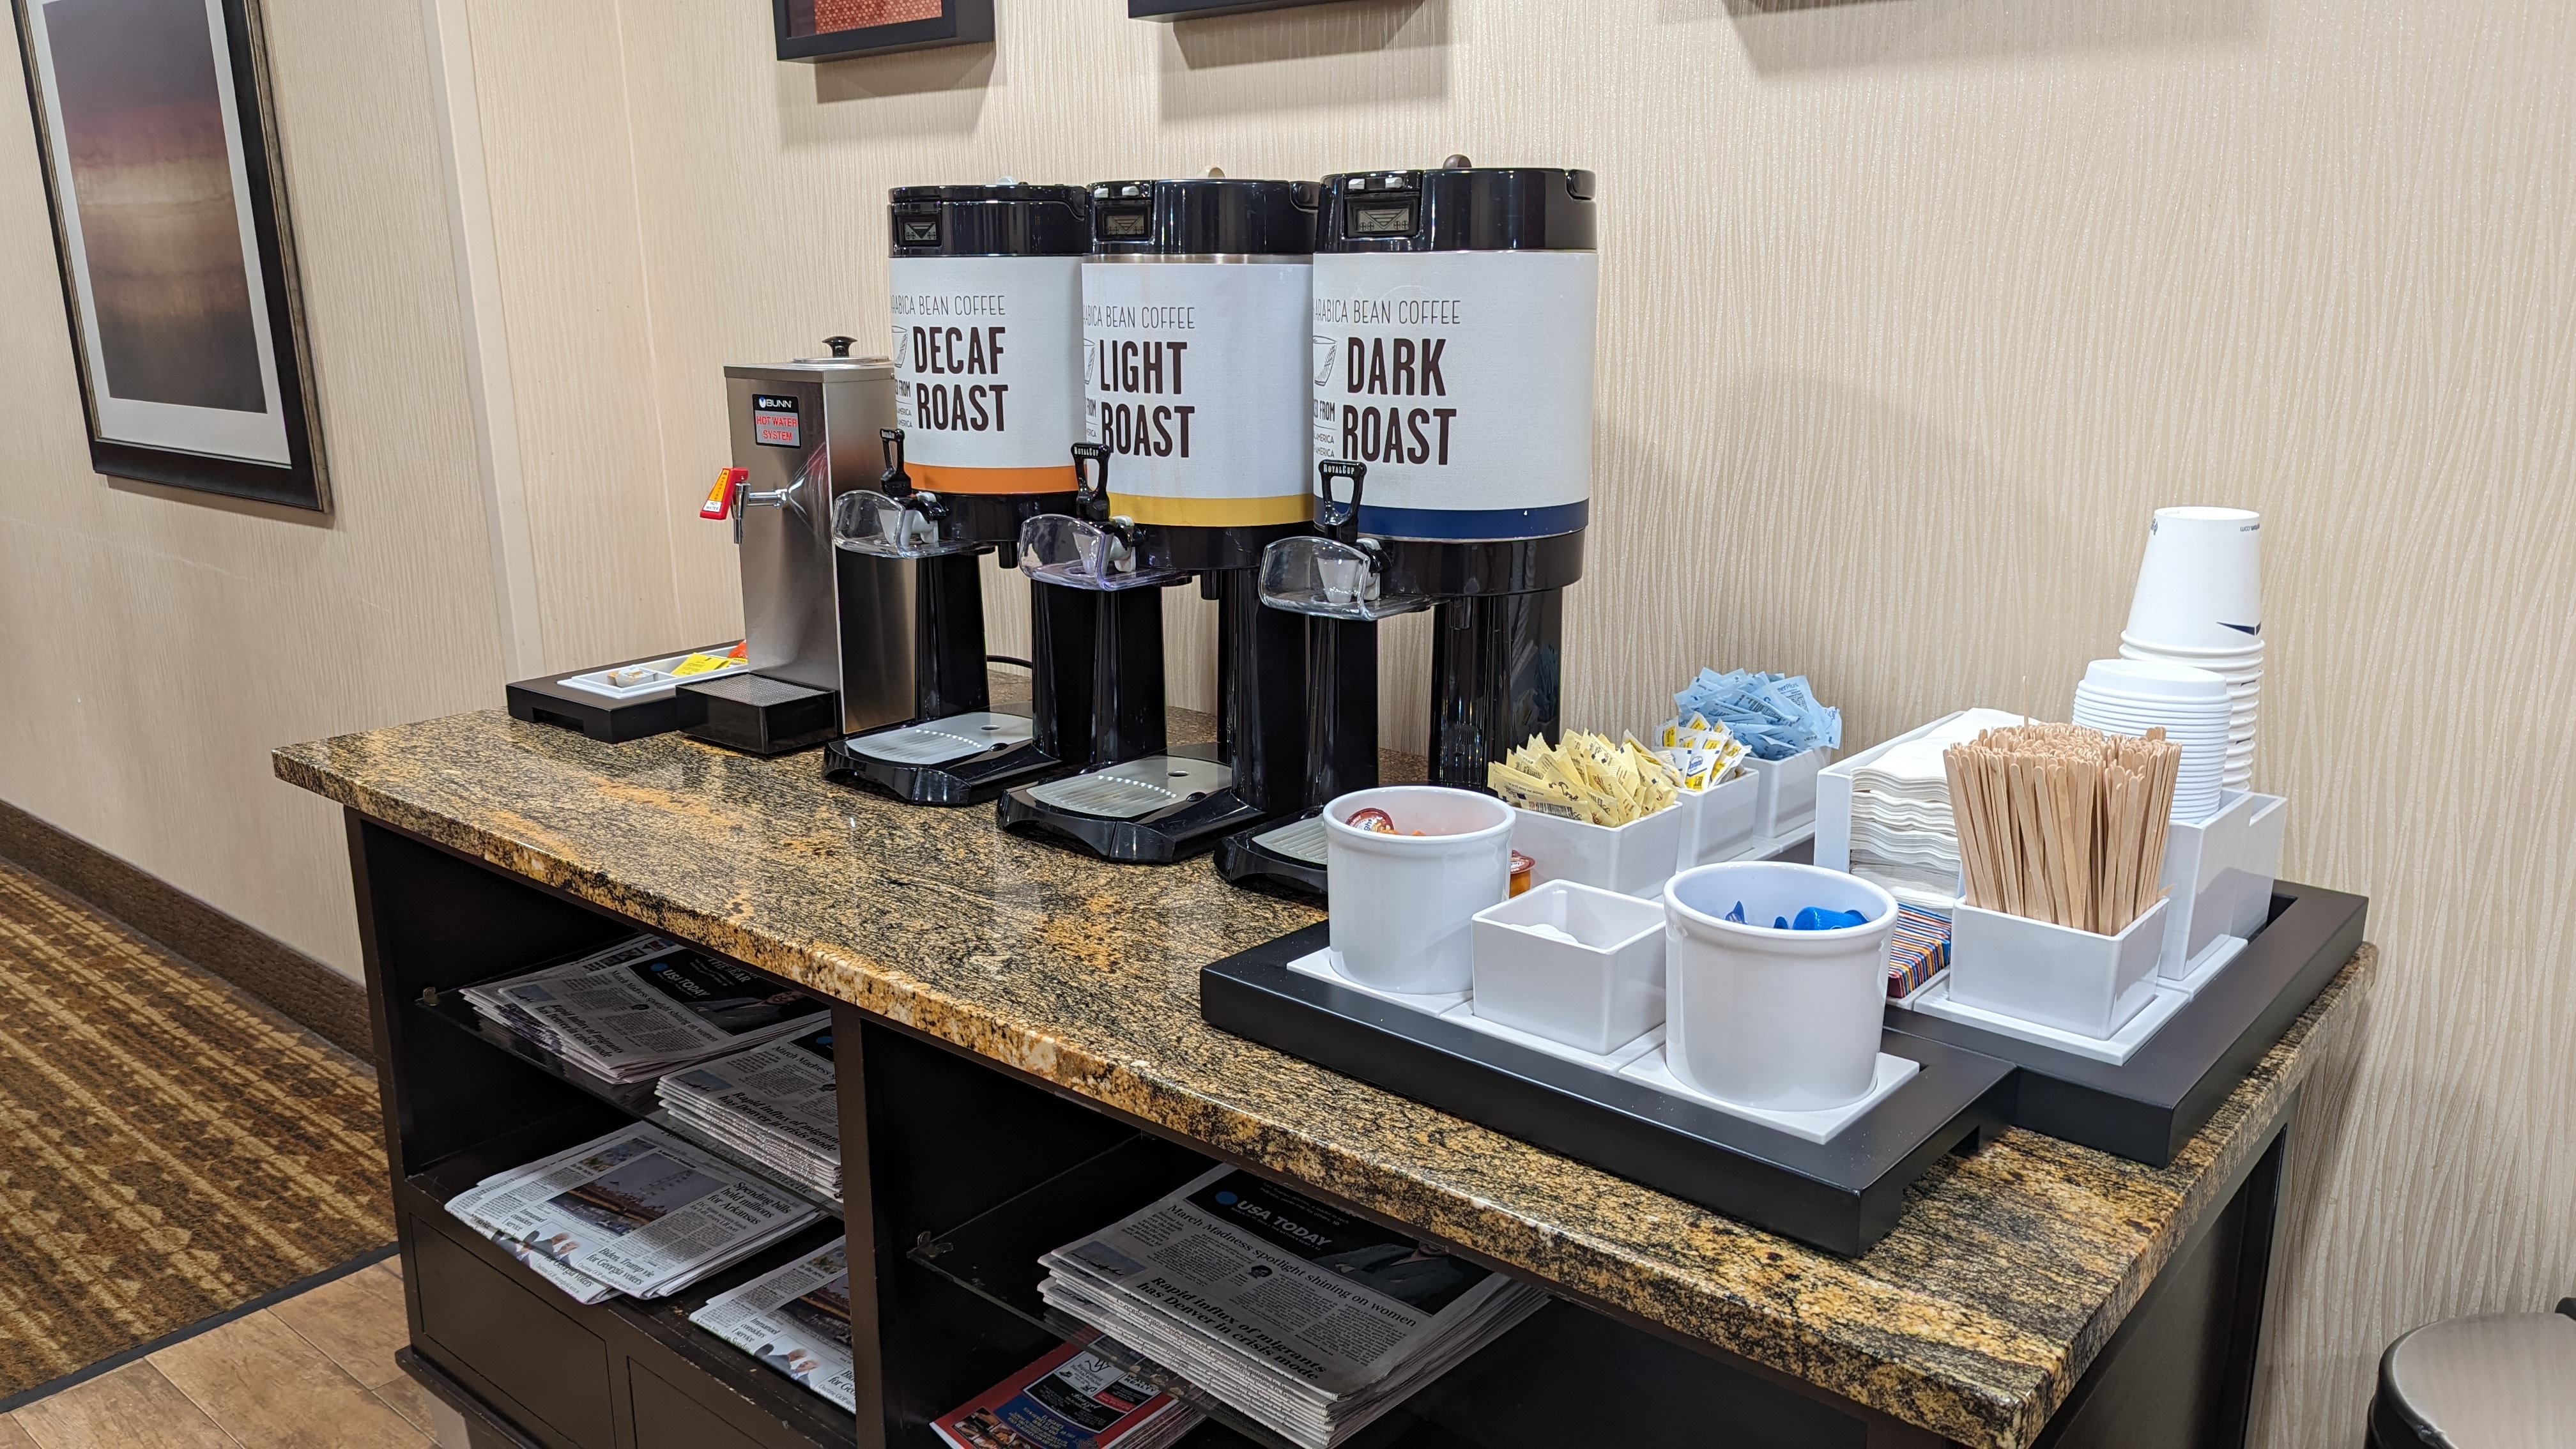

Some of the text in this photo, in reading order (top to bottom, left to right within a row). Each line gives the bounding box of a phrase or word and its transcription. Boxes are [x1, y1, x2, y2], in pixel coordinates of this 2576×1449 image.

[919, 295, 949, 316] BEAN
[954, 295, 1006, 316] COFFEE
[1107, 306, 1135, 328] BEAN
[1142, 307, 1195, 328] COFFEE
[1354, 300, 1390, 324] BEAN
[1399, 300, 1460, 324] COFFEE
[913, 326, 1005, 374] DECAF
[1100, 339, 1187, 394] LIGHT
[1347, 337, 1446, 396] DARK
[766, 399, 792, 408] BUNN
[916, 383, 1008, 431] ROAST
[1320, 401, 1335, 422] FROM
[756, 416, 797, 427] HOT WATER
[763, 429, 792, 441] SYSTEM
[1101, 402, 1195, 457] ROAST
[1342, 404, 1457, 465] ROAST
[678, 978, 710, 996] TODAY
[534, 1005, 555, 1015] has
[545, 1013, 571, 1029] Denver
[573, 1033, 599, 1045] crisis
[545, 1004, 576, 1016] Rapid
[567, 1015, 590, 1029] influx
[771, 1045, 832, 1075] March Madness
[727, 1091, 766, 1107] Rapid
[759, 1105, 792, 1121] influx
[717, 1095, 742, 1106] has
[735, 1103, 772, 1122] Denver
[779, 1125, 809, 1138] crisis
[806, 1137, 837, 1151] mode
[707, 1193, 761, 1225] for Arkansas
[720, 1187, 774, 1218] hold millions
[733, 1181, 791, 1214] Spending bills
[510, 1213, 534, 1226] considers
[1237, 1200, 1271, 1220] USA
[1273, 1215, 1332, 1245] TODAY
[585, 1254, 644, 1285] for Georgia voters
[597, 1247, 620, 1262] Biden,
[619, 1257, 645, 1273] Trump
[1167, 1204, 1203, 1226] March
[1202, 1223, 1254, 1251] Madness
[1252, 1249, 1306, 1276] spotlight
[1304, 1275, 1352, 1298] shining
[1351, 1295, 1368, 1306] on
[1370, 1303, 1416, 1327] women
[574, 1273, 595, 1287] voters
[740, 1323, 766, 1338] considers
[749, 1317, 781, 1335] Immanuel
[1135, 1282, 1165, 1298] has
[1162, 1296, 1216, 1324] Denver
[1213, 1322, 1231, 1334] in
[1231, 1333, 1276, 1356] crisis
[1273, 1355, 1319, 1379] mode
[1150, 1276, 1197, 1301] Rapid
[1192, 1298, 1239, 1324] influx
[1238, 1324, 1261, 1333] of
[1255, 1333, 1326, 1372] migrants
[828, 1376, 843, 1386] for
[1125, 1377, 1155, 1392] REALTY
